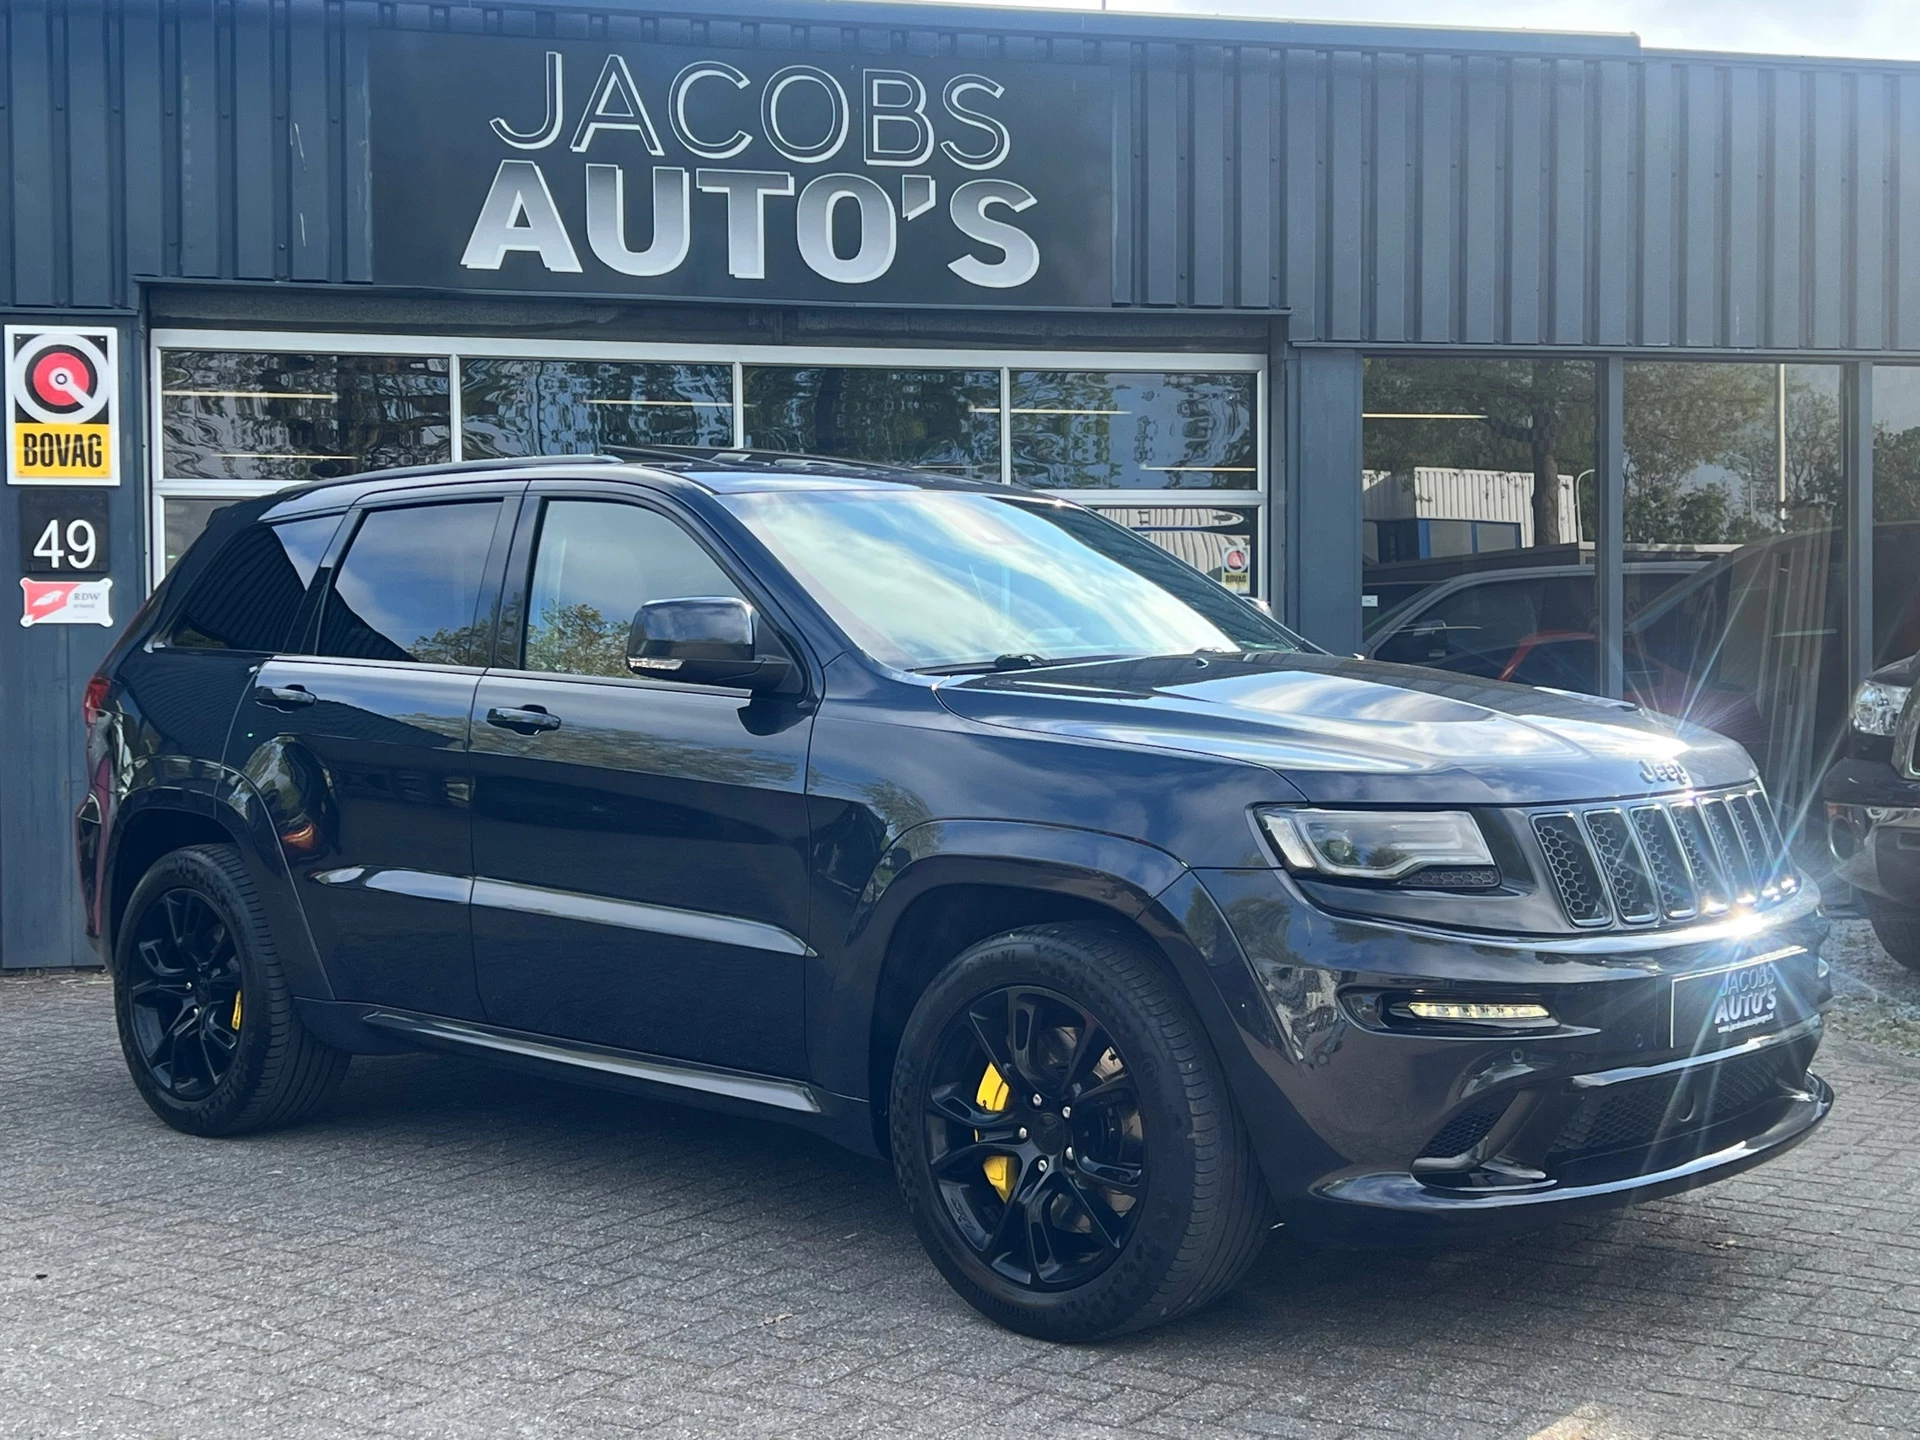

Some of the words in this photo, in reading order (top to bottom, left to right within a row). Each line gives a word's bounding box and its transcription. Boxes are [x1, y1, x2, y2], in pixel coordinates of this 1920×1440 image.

[489, 50, 1010, 171] JACOBS
[459, 158, 1040, 289] AUTO'S
[23, 432, 103, 468] BOVAG
[33, 519, 96, 569] 49
[74, 592, 100, 601] RDW
[1639, 759, 1690, 785] Jeep
[1720, 963, 1775, 997] JACOBS
[1714, 987, 1777, 1024] AUTO'S
